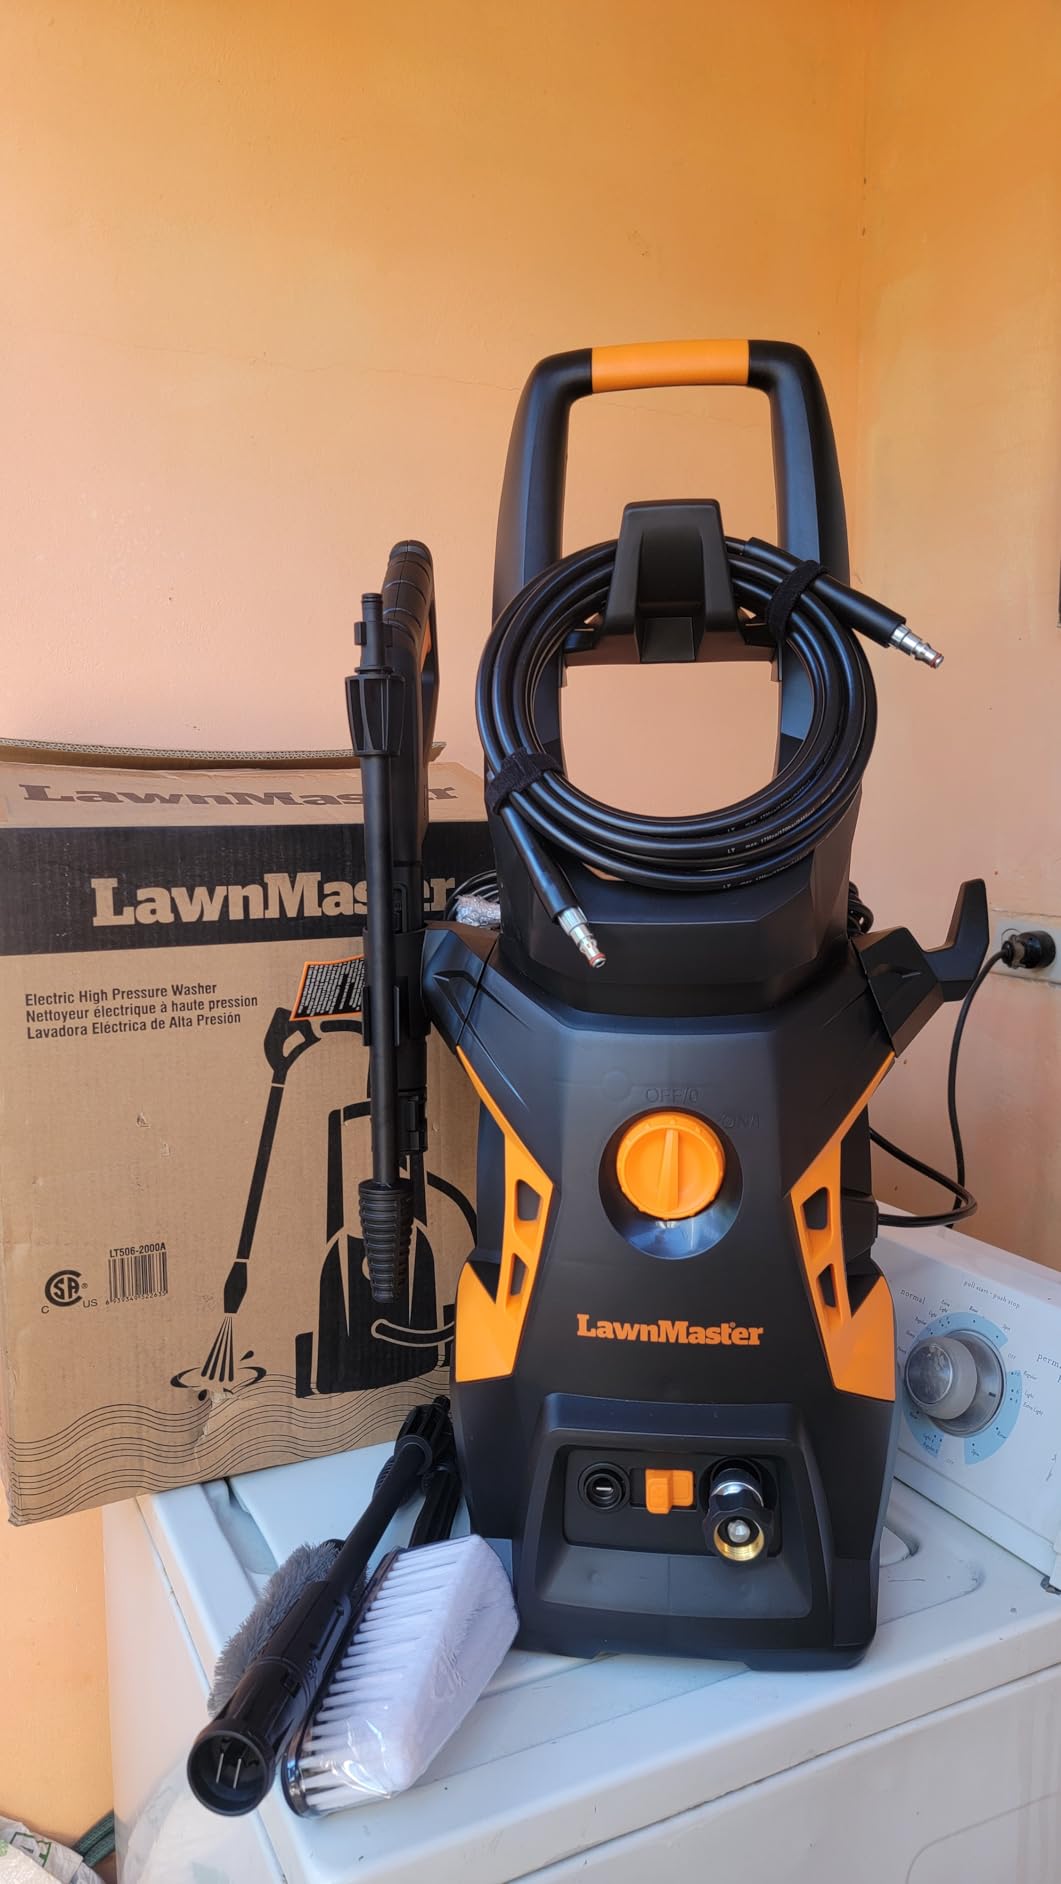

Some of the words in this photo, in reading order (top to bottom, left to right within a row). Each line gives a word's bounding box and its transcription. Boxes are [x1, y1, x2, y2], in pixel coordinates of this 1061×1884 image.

[18, 783, 458, 805] LawnMasr
[91, 872, 455, 926] LawnMasr
[25, 991, 74, 1006] Electric
[79, 989, 108, 1005] High
[112, 985, 167, 1001] Pressure
[171, 982, 217, 996] Washer
[26, 1007, 89, 1023] Nettoyeur
[94, 1003, 156, 1019] électrique
[160, 1000, 168, 1013] à
[171, 997, 205, 1012] haute
[208, 995, 258, 1010] pression
[27, 1024, 88, 1040] Lavadora
[92, 1019, 147, 1035] Eléctrica
[150, 1017, 166, 1030] de
[169, 1015, 193, 1028] Alta
[197, 1011, 241, 1026] Presión
[109, 1242, 166, 1258] LT506-2000A
[82, 1299, 98, 1308] US
[900, 1288, 926, 1304] normal
[41, 1305, 50, 1314] C
[577, 1313, 764, 1345] LawnMaster
